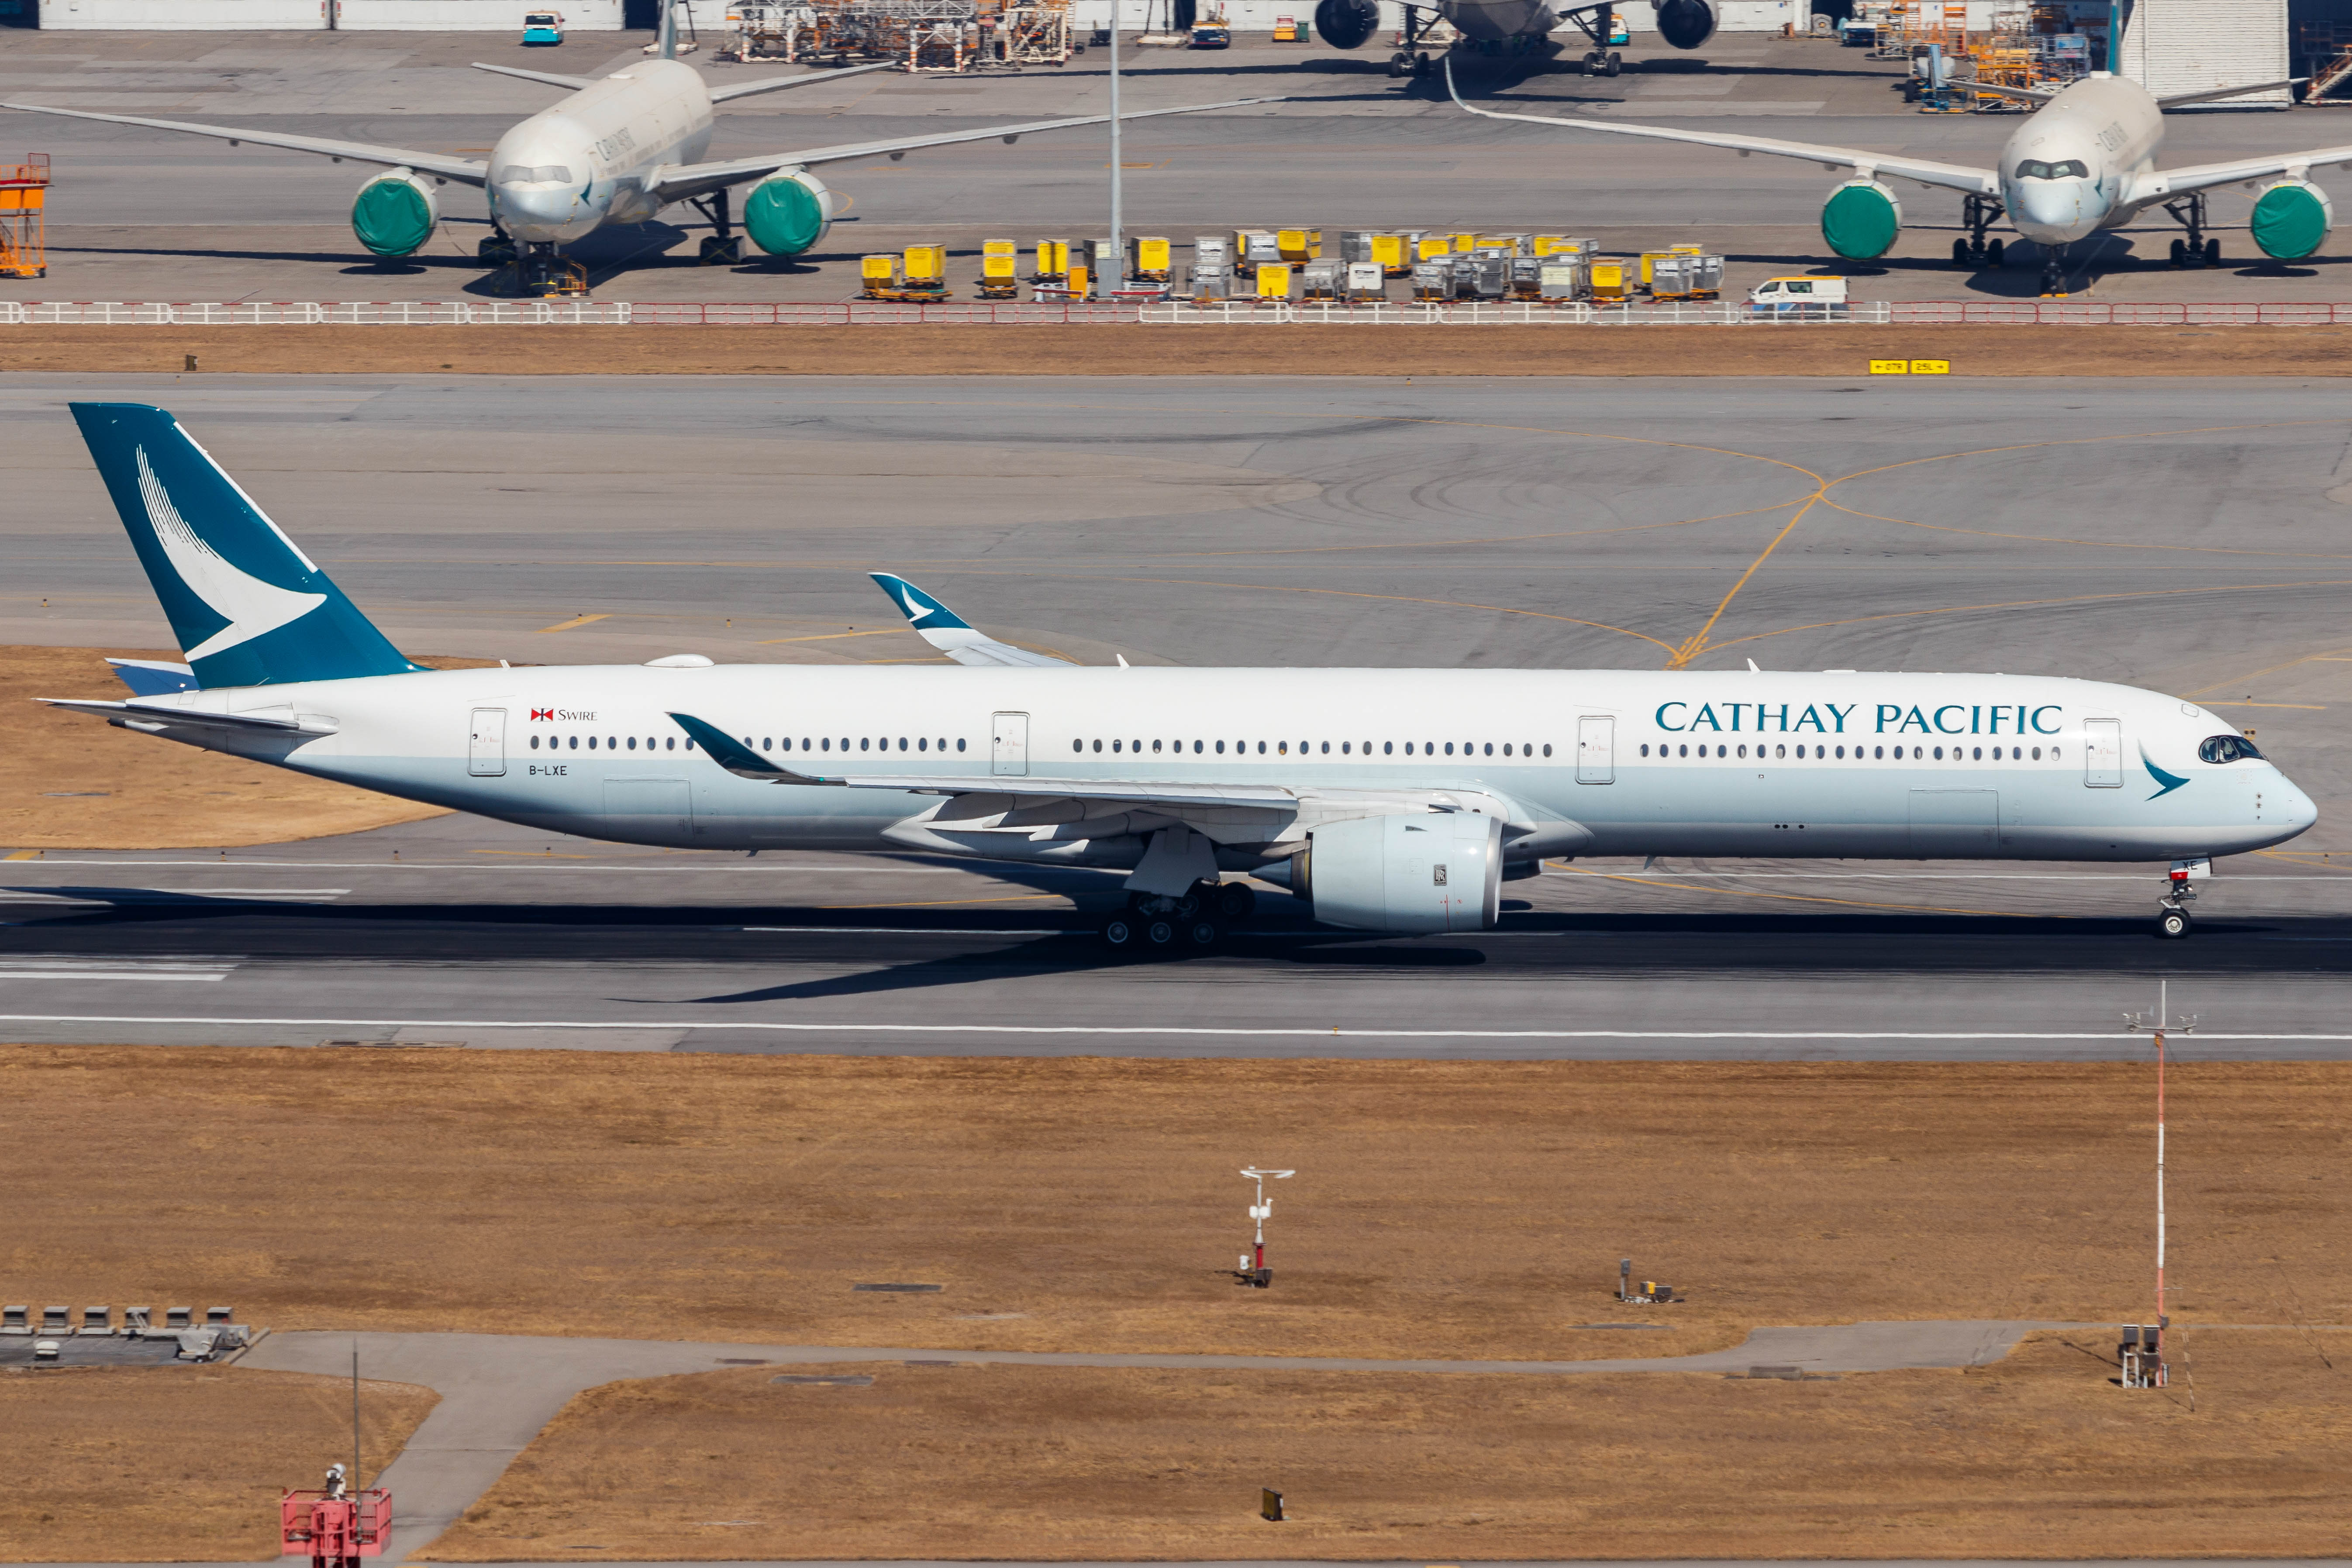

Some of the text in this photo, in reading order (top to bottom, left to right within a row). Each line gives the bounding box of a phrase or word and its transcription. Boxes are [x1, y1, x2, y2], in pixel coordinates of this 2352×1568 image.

[1655, 702, 2062, 734] CATHAY PACIFIC
[529, 765, 567, 776] B-LXE
[2183, 860, 2197, 871] XE
